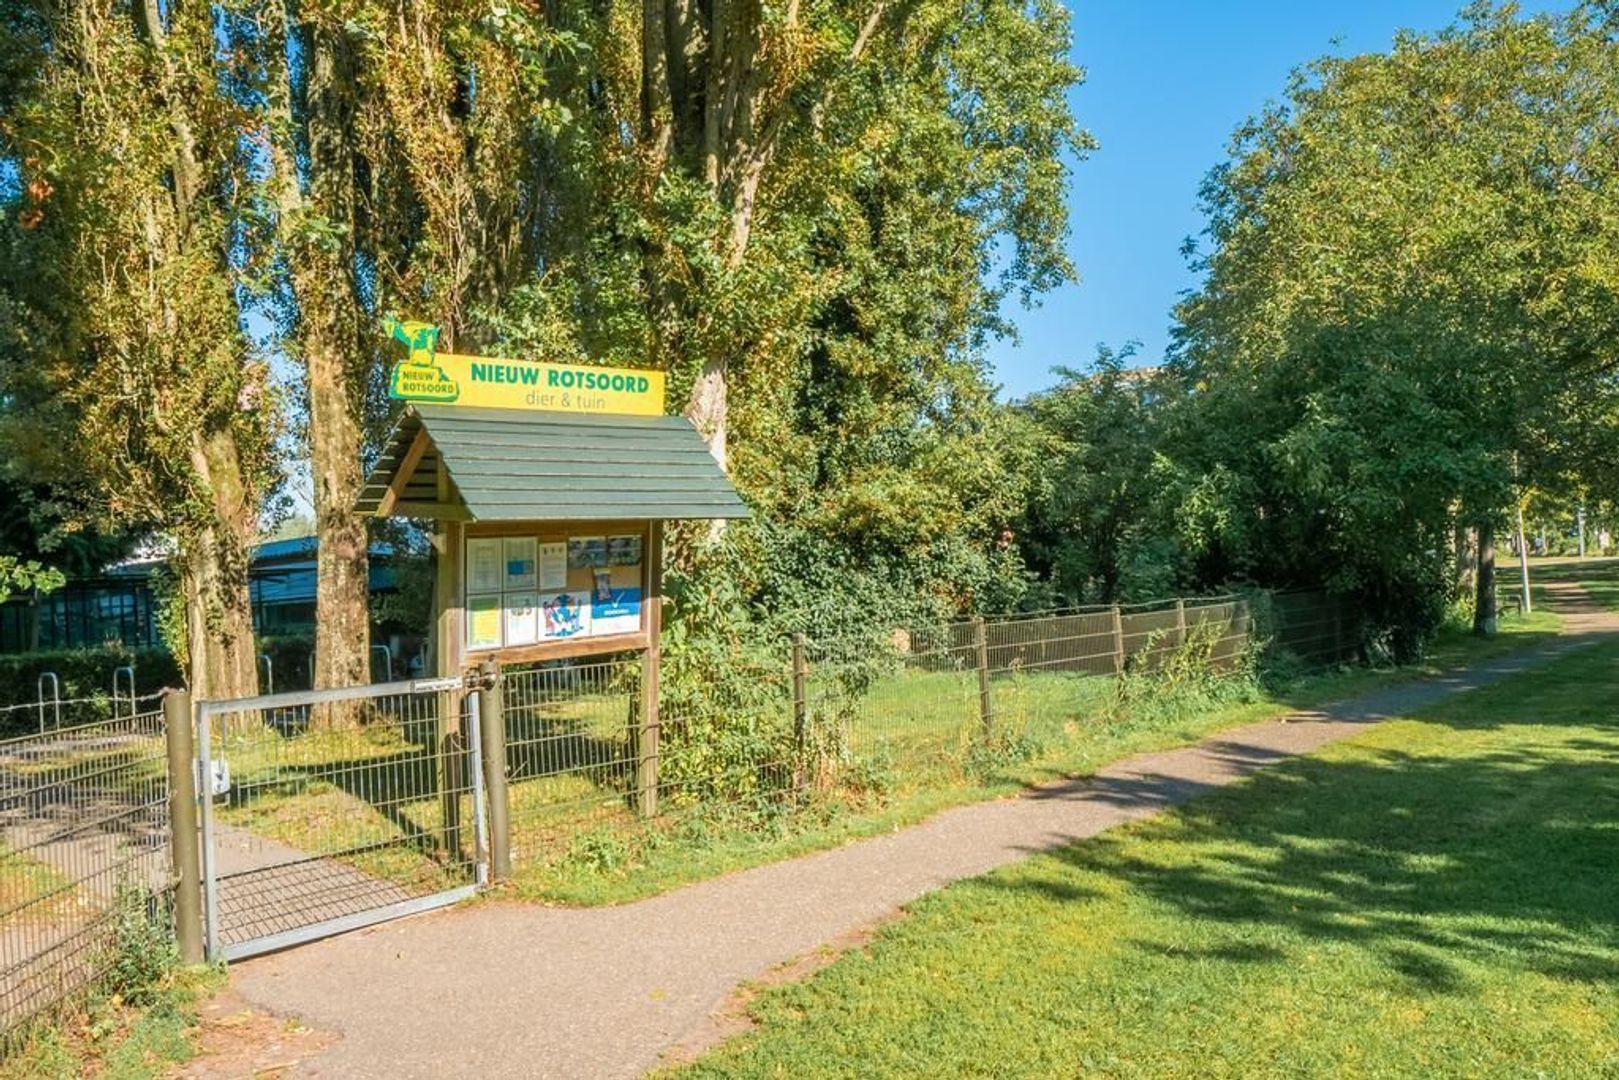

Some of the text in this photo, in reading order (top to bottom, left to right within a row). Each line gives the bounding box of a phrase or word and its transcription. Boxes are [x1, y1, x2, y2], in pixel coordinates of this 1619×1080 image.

[403, 371, 433, 381] NIEUW
[471, 363, 649, 393] NIEUW ROTSOORD
[403, 383, 454, 394] ROTSOORD
[526, 391, 605, 409] dier & tuin
